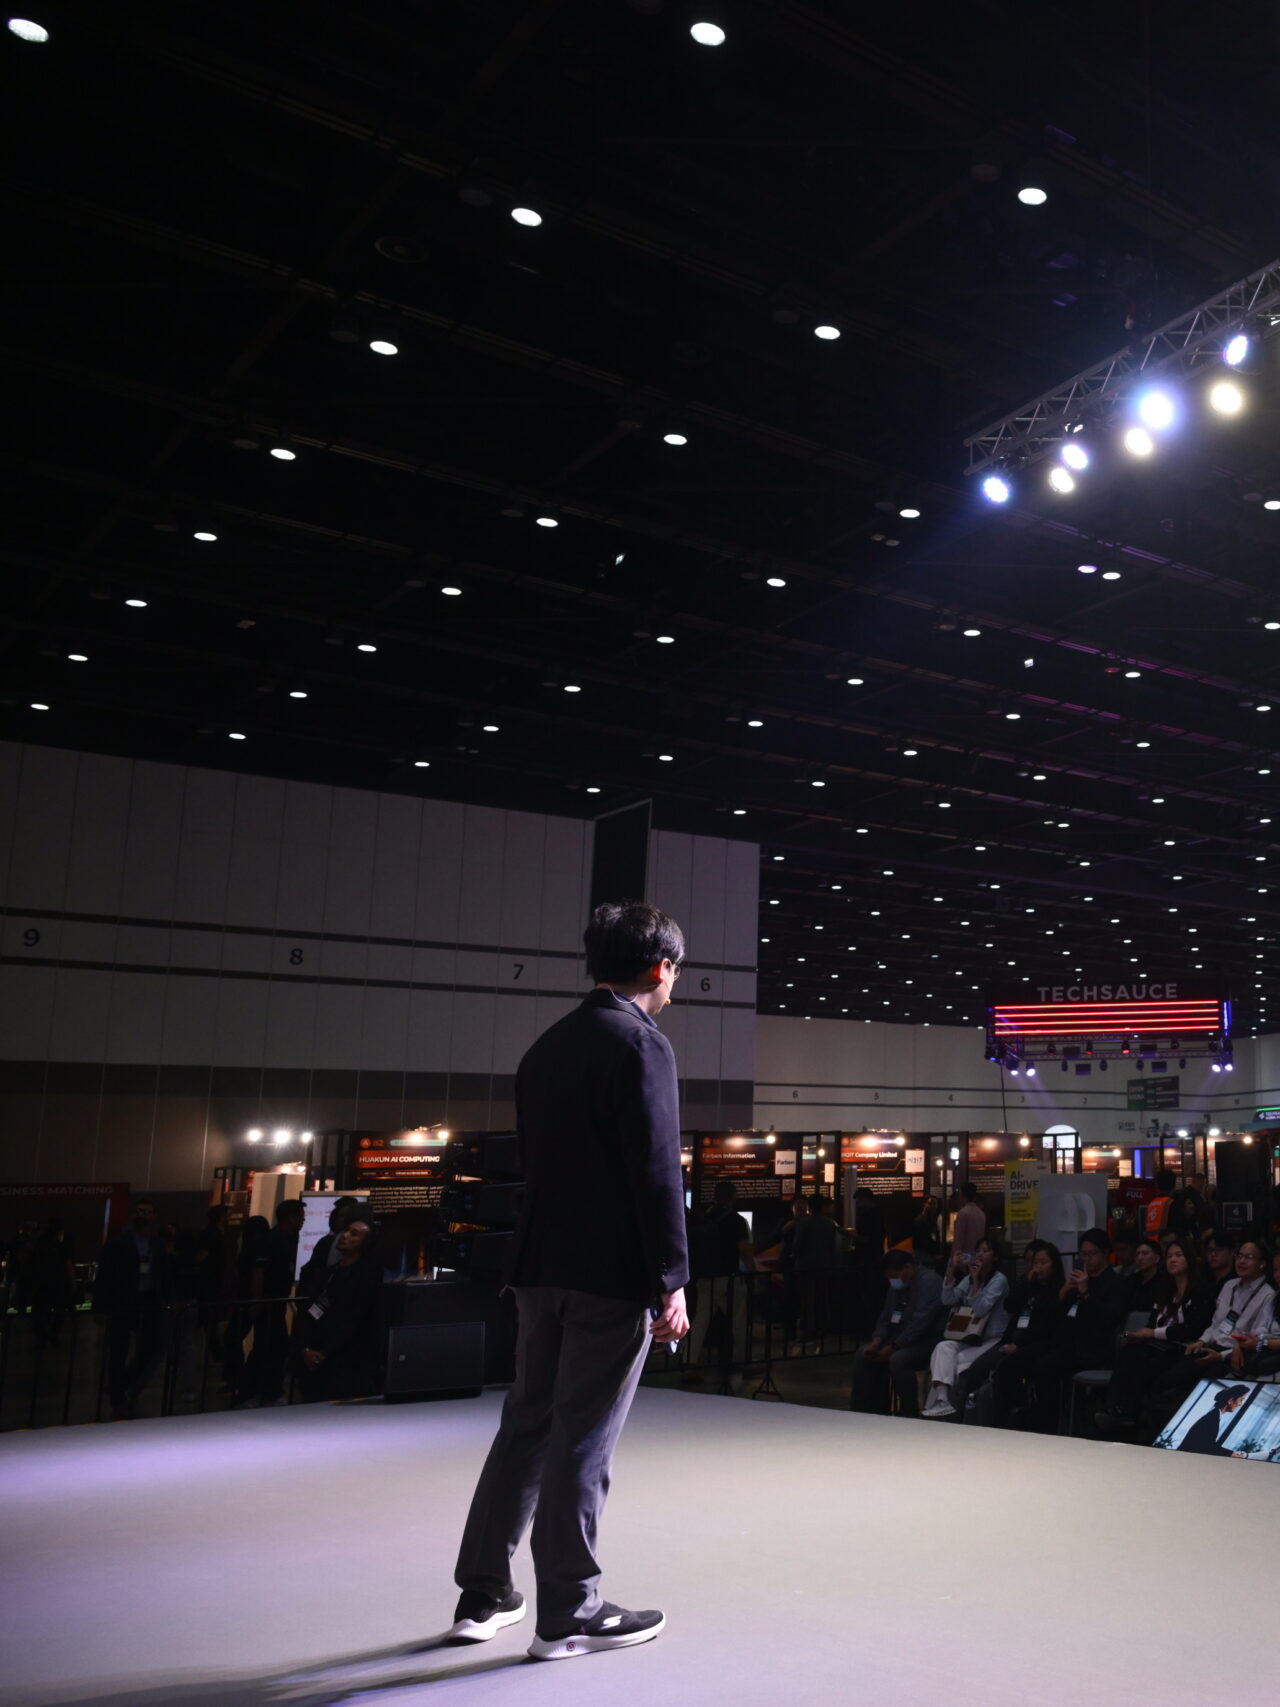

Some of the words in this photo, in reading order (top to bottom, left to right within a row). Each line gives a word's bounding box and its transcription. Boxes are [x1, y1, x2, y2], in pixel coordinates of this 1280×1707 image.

[23, 928, 41, 947] 9
[289, 948, 304, 965] 8
[513, 963, 524, 980] 7
[700, 976, 711, 992] 6
[1036, 983, 1178, 1003] TECHSAUCE
[793, 1090, 798, 1099] 6
[874, 1092, 879, 1101] 5
[47, 1185, 113, 1195] MATCHING
